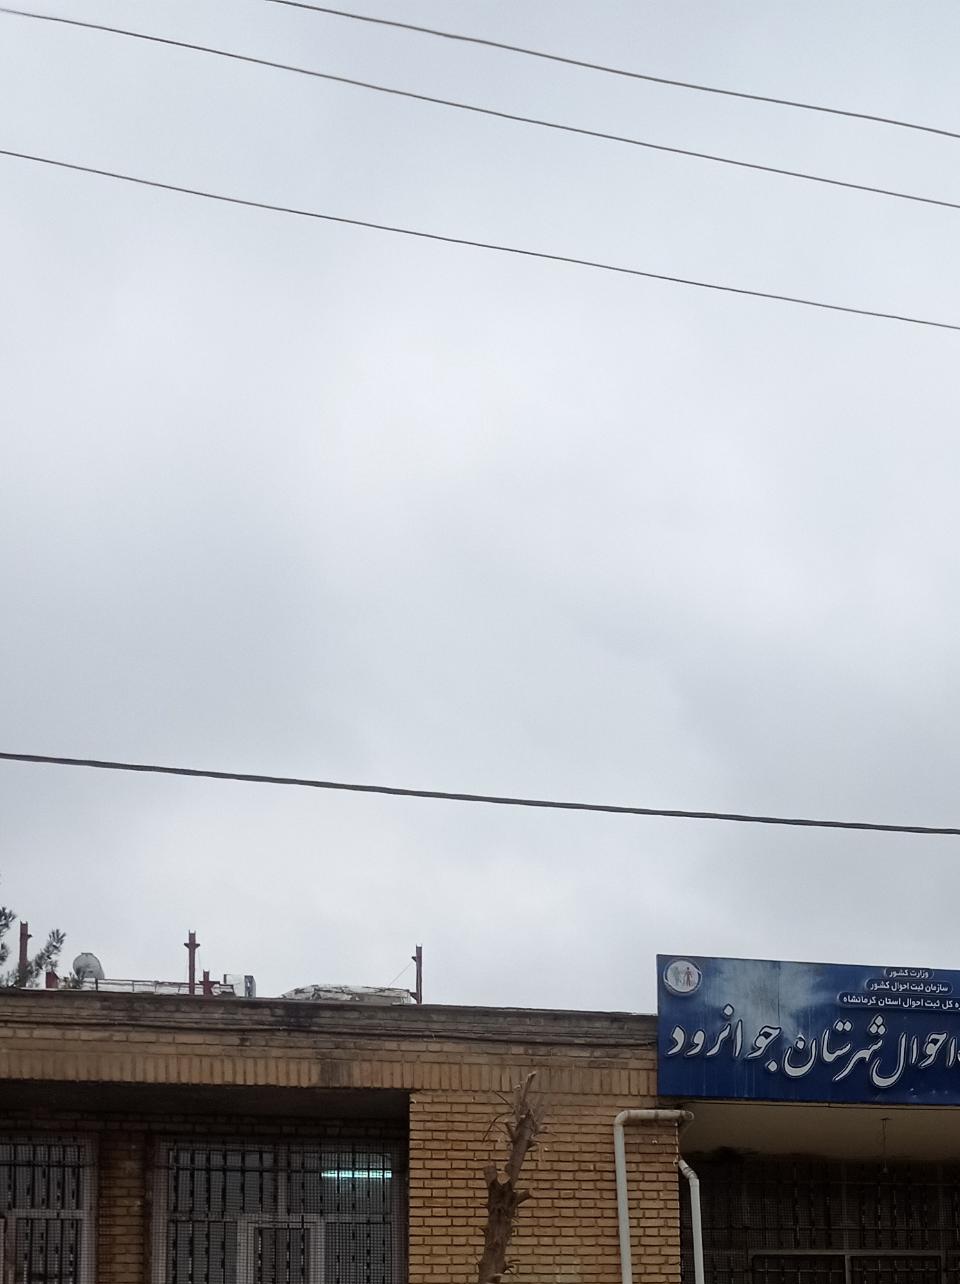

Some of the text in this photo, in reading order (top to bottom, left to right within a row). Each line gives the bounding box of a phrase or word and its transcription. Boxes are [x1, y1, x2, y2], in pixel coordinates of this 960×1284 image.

[888, 968, 930, 979] وزارت کشور
[870, 981, 949, 993] سازمان ثبت احوال کشور
[843, 995, 876, 1006] کرمانشاه
[877, 997, 901, 1007] استان
[902, 998, 924, 1008] احوال
[924, 1000, 940, 1009] ثبت
[941, 999, 954, 1010] کل
[666, 1003, 782, 1073] جوانرود
[782, 1014, 886, 1082] شهرستان
[871, 1031, 957, 1087] احوال
